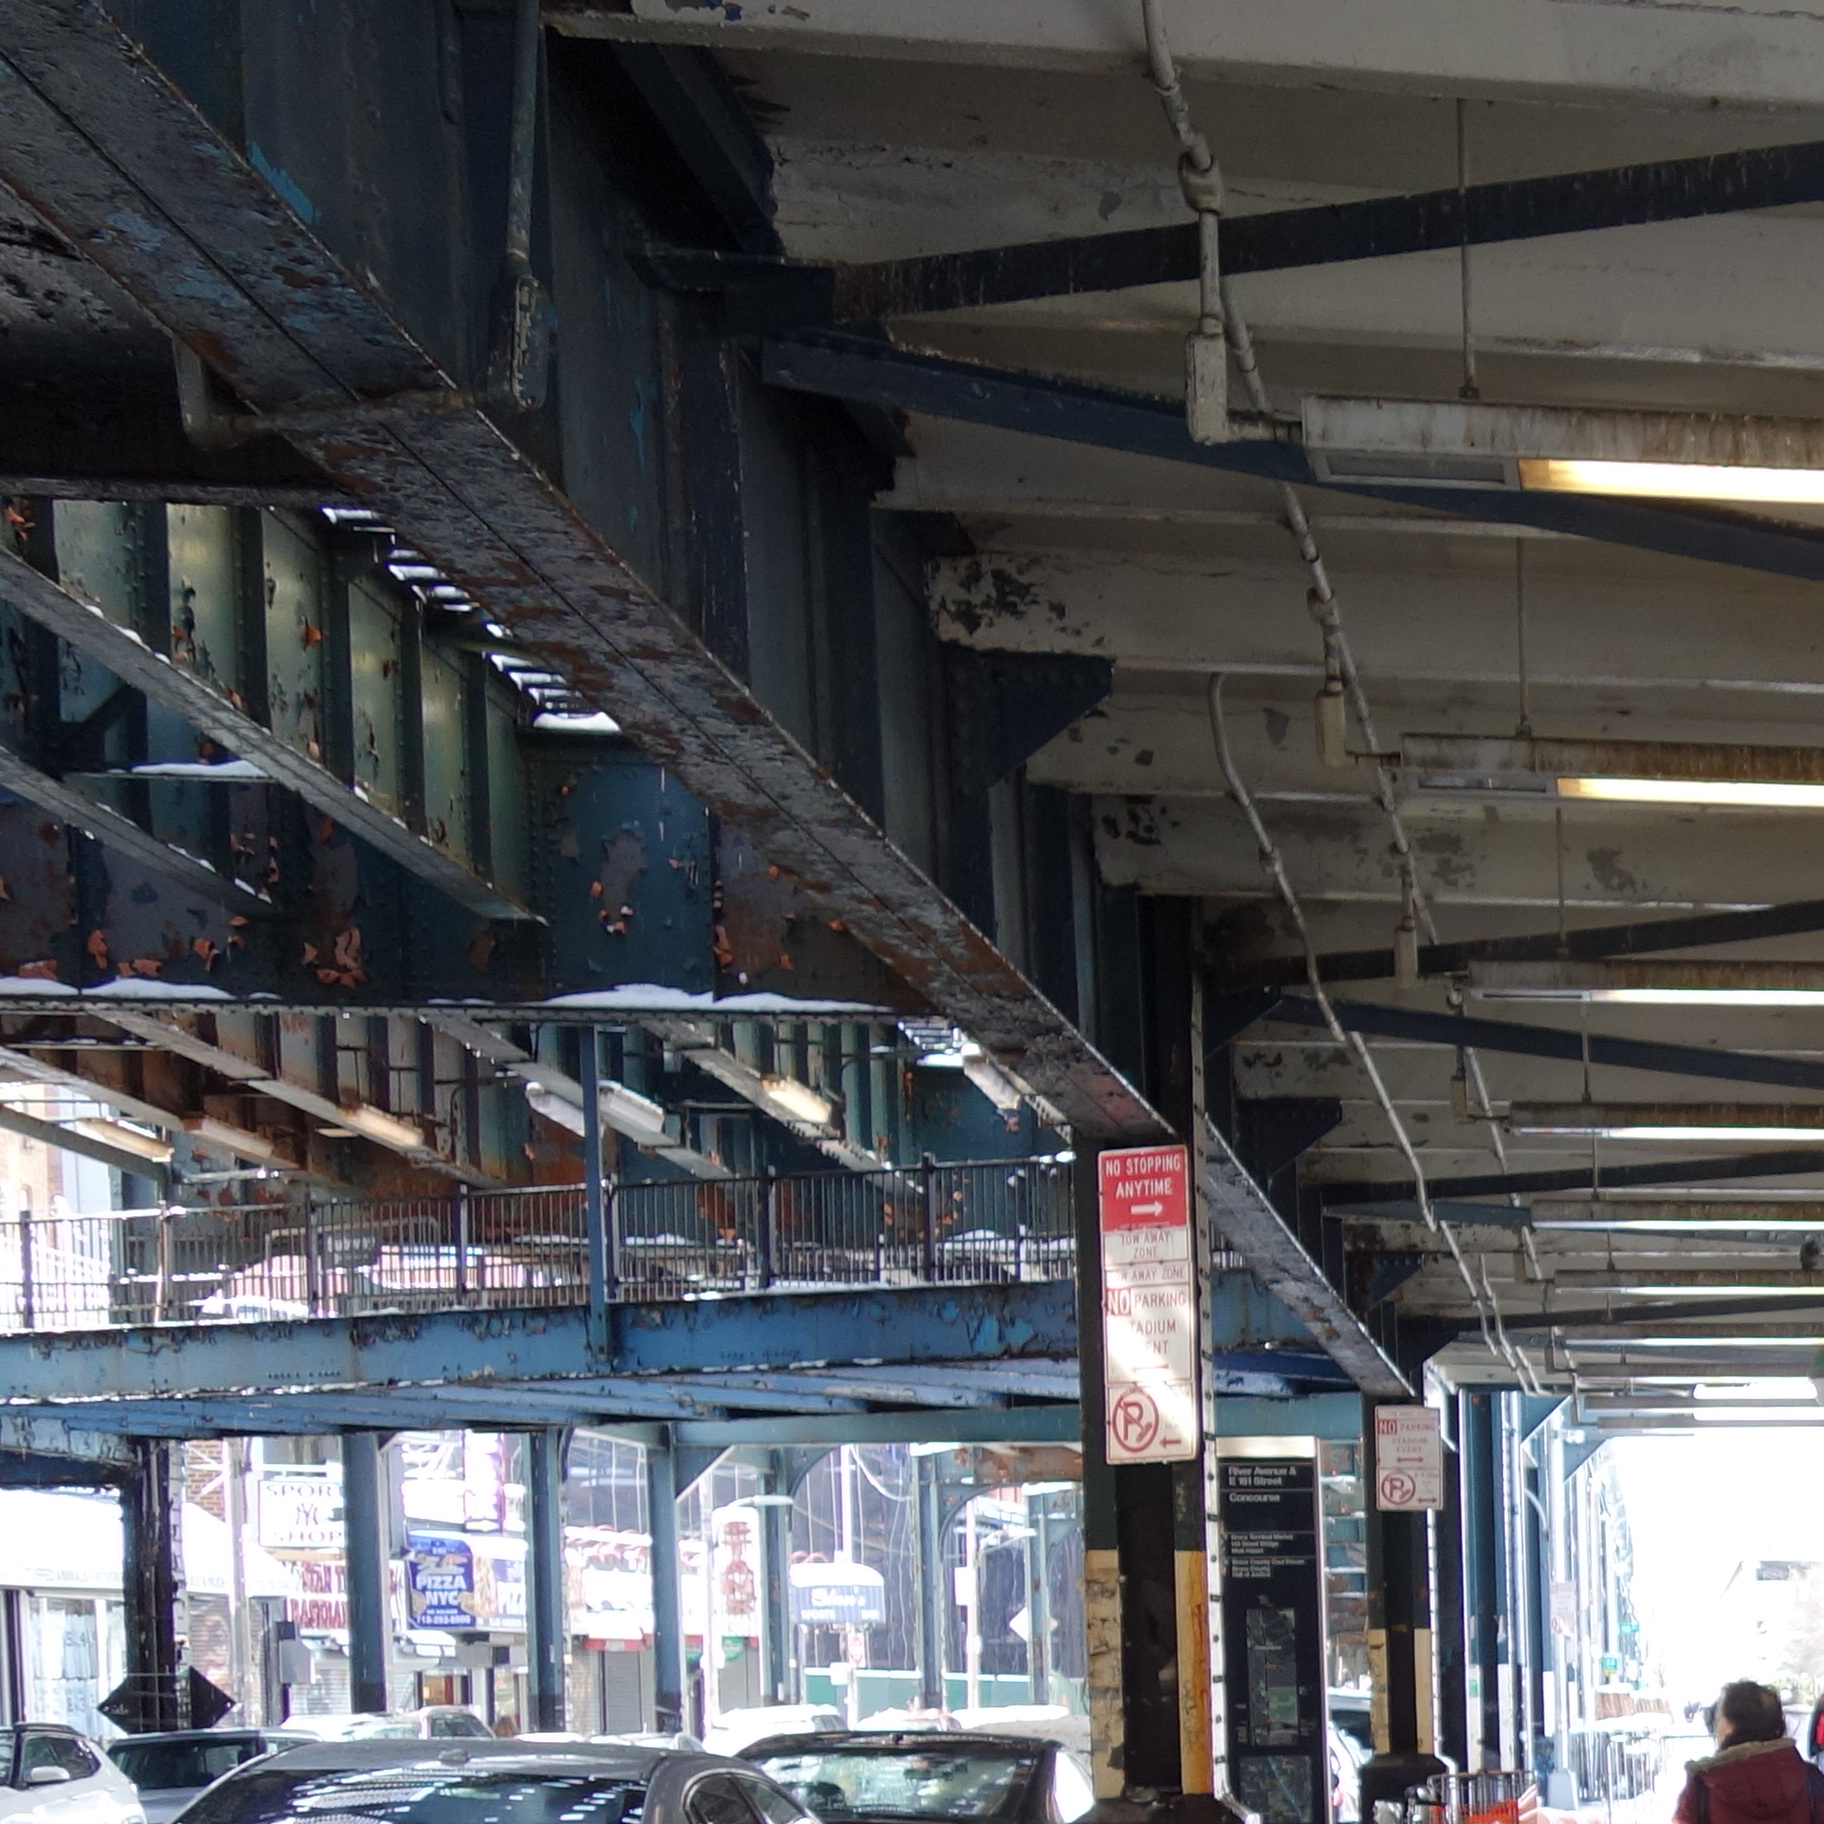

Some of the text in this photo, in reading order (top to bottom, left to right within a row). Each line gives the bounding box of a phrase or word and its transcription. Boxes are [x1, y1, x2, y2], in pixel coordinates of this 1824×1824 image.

[1106, 1154, 1180, 1176] NO STOPPING
[1115, 1177, 1173, 1199] ANYTIME
[1144, 1229, 1173, 1244] AWAY
[1133, 1247, 1158, 1260] ZONE
[1132, 1270, 1157, 1281] AWAY
[1161, 1268, 1185, 1280] ZONE
[1107, 1290, 1186, 1316] NO PARKING
[1130, 1319, 1176, 1334] TADIUM
[1381, 1420, 1435, 1434] NO PARKING
[266, 1484, 332, 1498] SPOR
[416, 1573, 467, 1590] PIZZA
[425, 1591, 459, 1606] NYC
